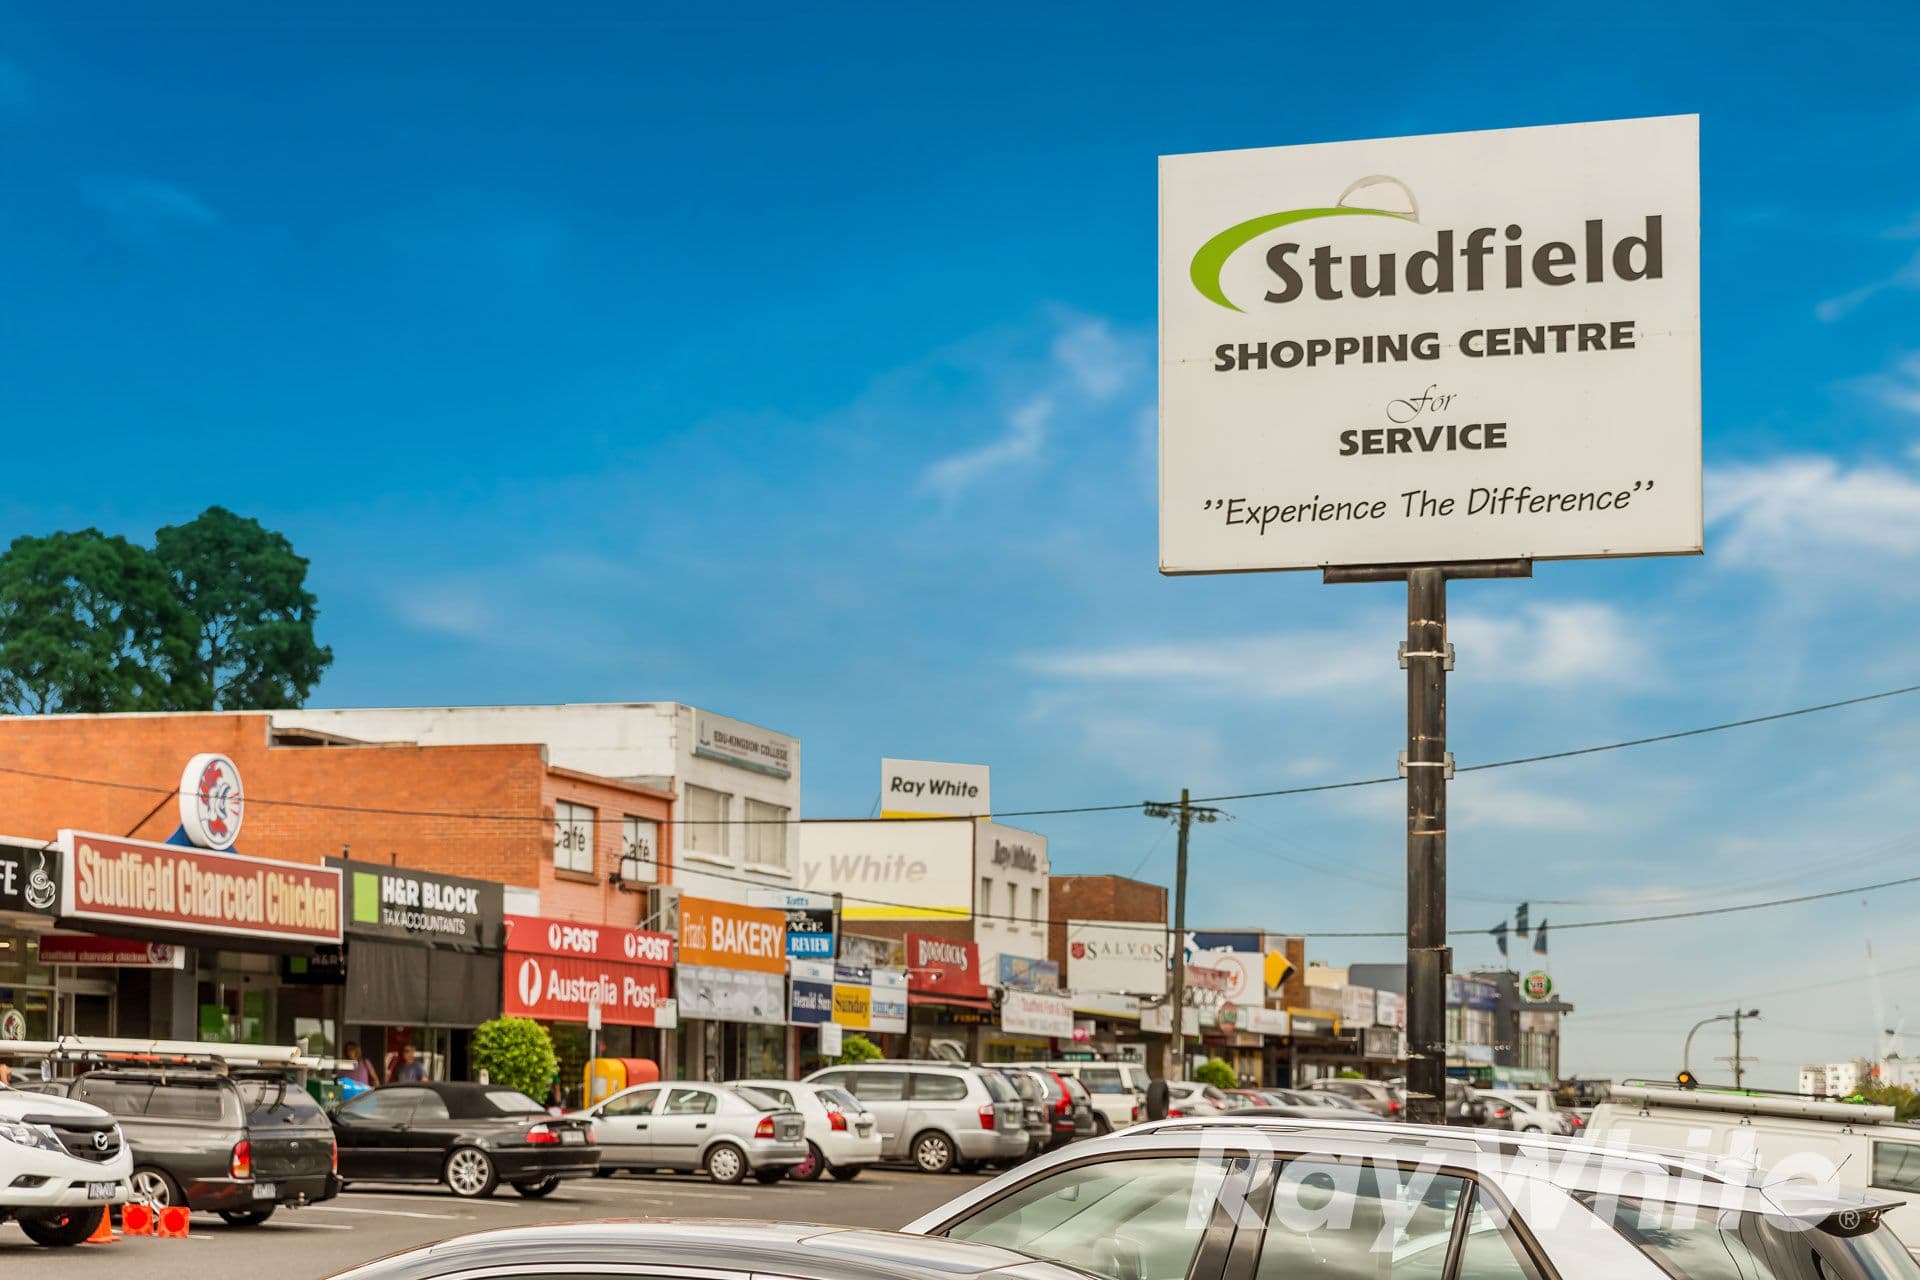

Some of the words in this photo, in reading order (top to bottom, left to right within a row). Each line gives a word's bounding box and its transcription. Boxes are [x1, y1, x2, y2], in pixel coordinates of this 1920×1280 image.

[1264, 215, 1663, 303] Studfield
[1214, 332, 1440, 371] SHOPPING
[1459, 320, 1635, 358] CENTRE
[1339, 422, 1507, 456] SERVICE
[1400, 490, 1454, 518] The
[760, 744, 788, 761] COLLEGE
[891, 776, 925, 797] Ray
[929, 778, 978, 798] White
[830, 854, 928, 884] White
[79, 844, 176, 913] Studfield
[178, 858, 264, 923] Charcoal
[266, 871, 337, 931] Chicken
[382, 875, 419, 907] H&R
[422, 881, 479, 915] BLOCK
[383, 908, 400, 927] TAX
[399, 911, 466, 935] ACCOUNTANTS
[788, 922, 824, 933] AGE
[563, 927, 599, 953] POST
[637, 937, 670, 961] POST
[711, 915, 784, 960] BAKERY
[791, 937, 830, 953] REVIEW
[1086, 942, 1164, 962] SALVOS
[547, 969, 618, 1006] Australia
[623, 977, 658, 1009] Post
